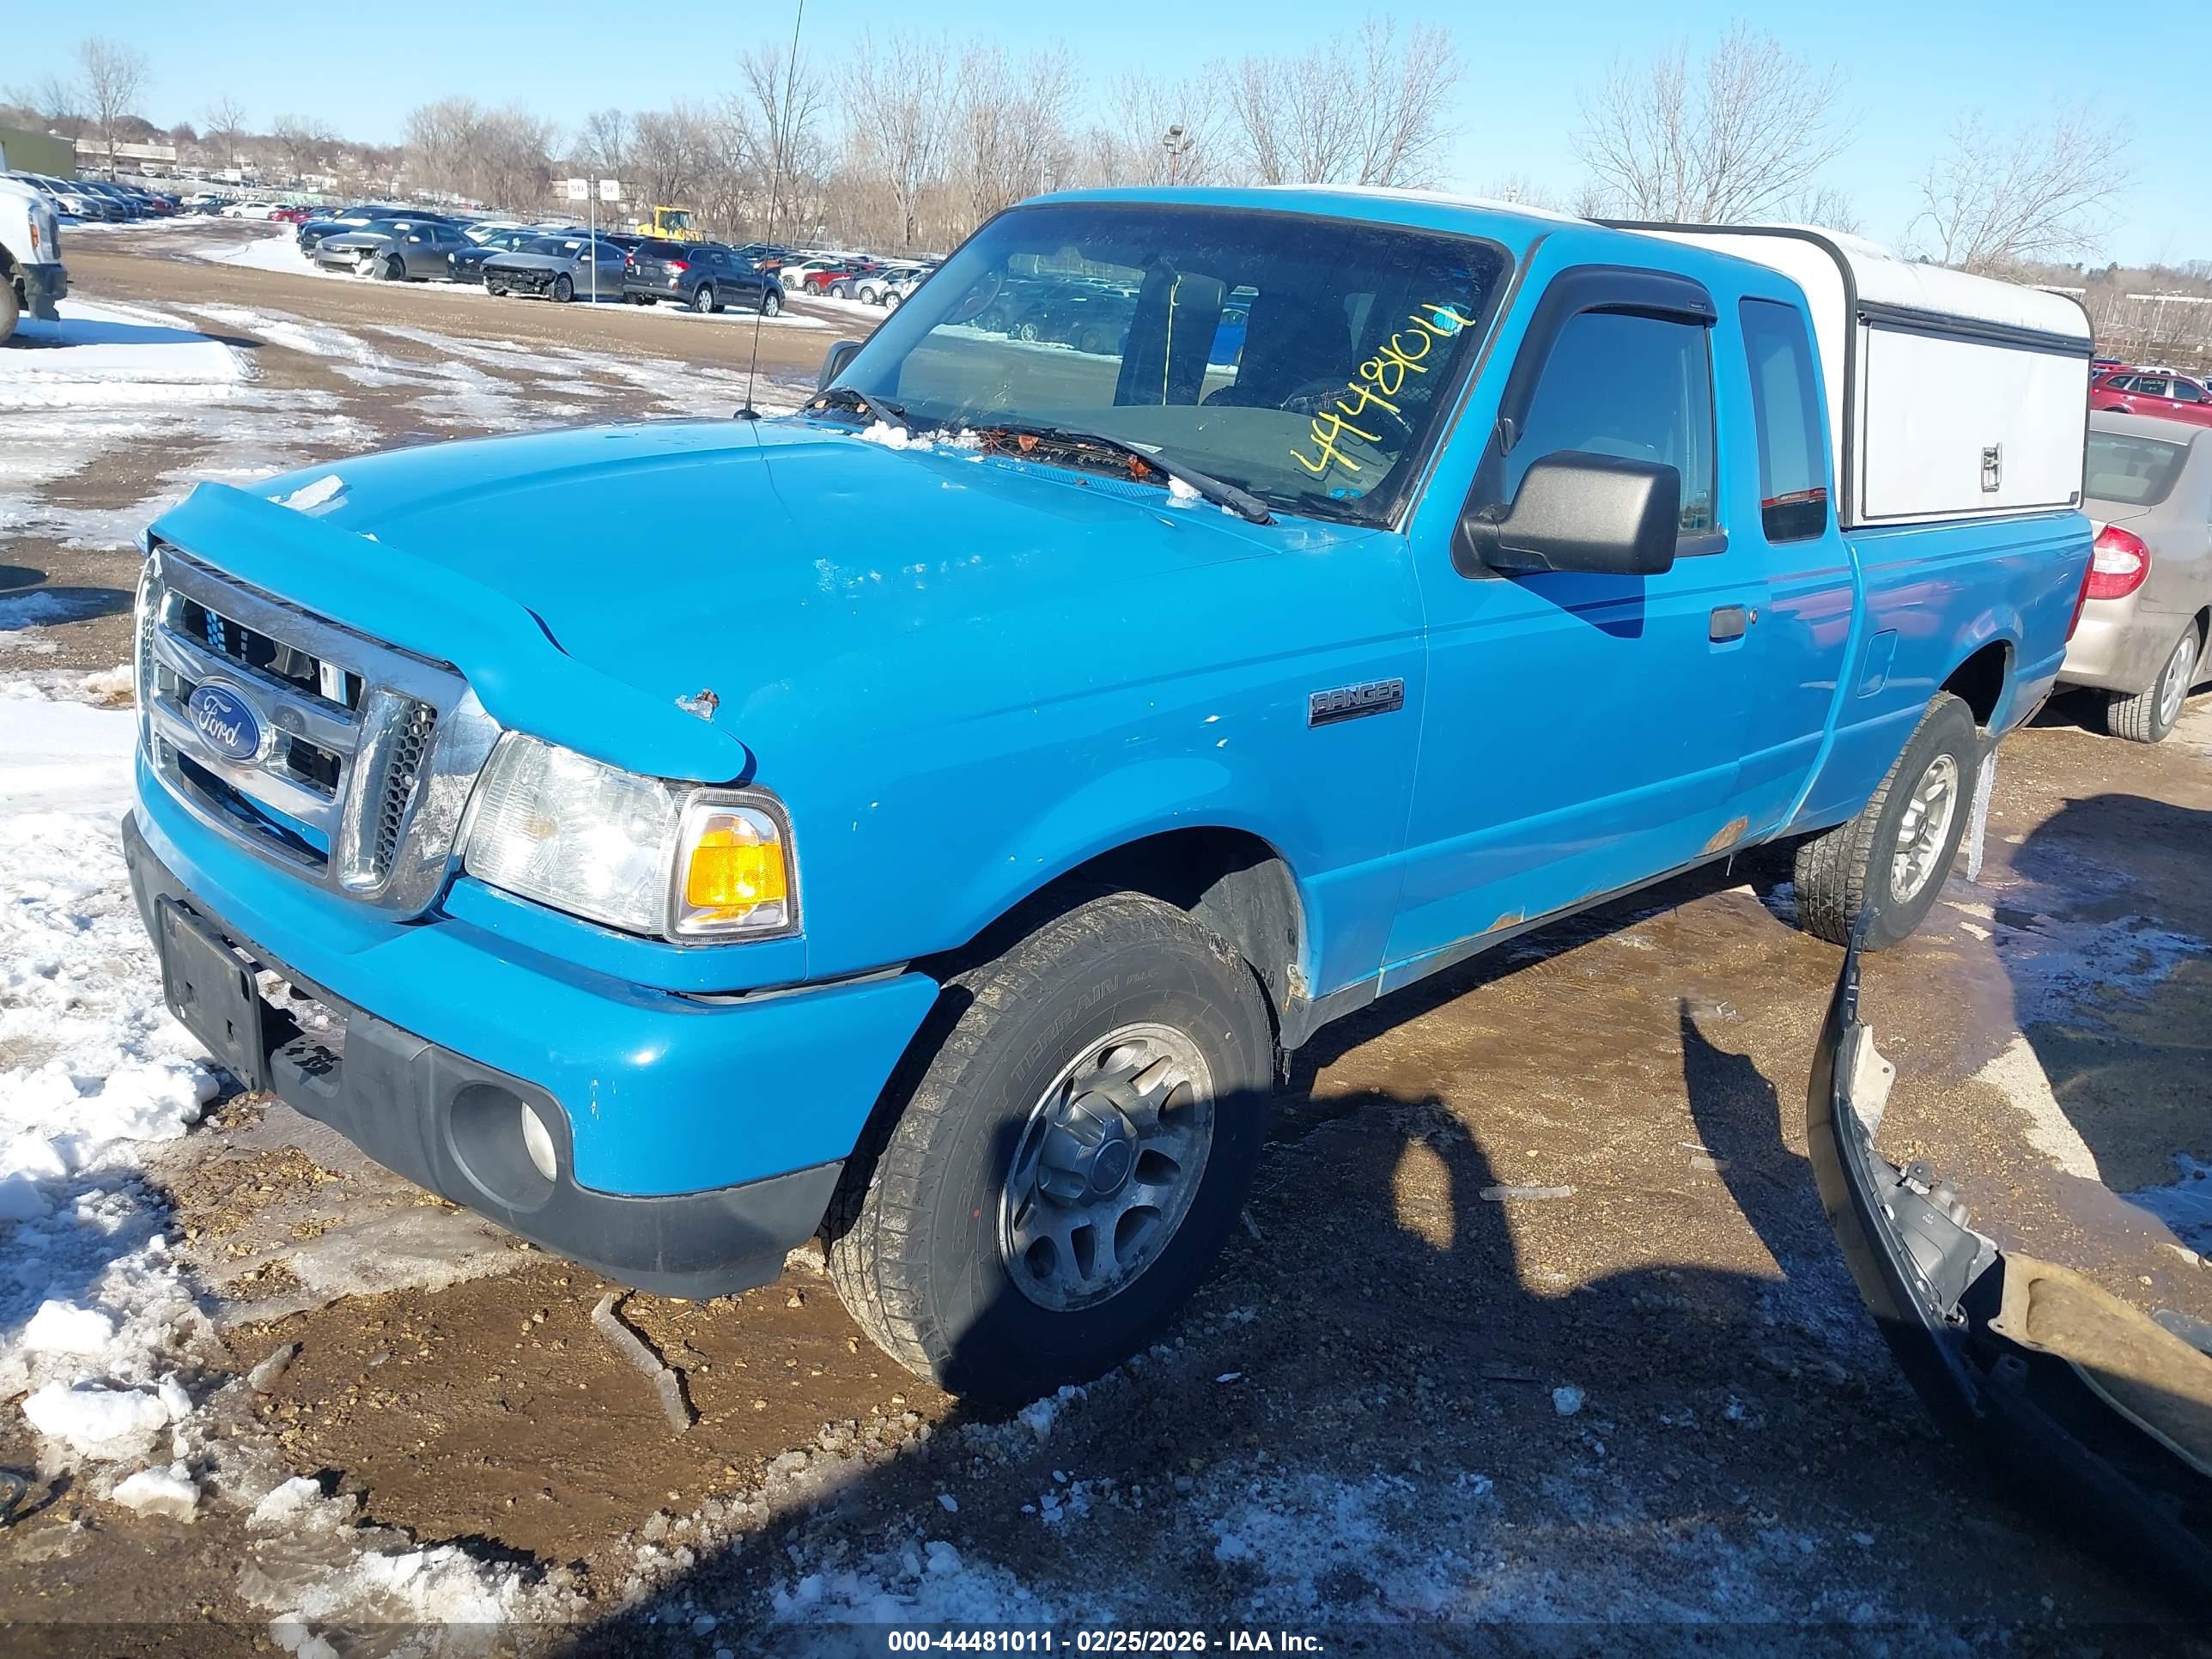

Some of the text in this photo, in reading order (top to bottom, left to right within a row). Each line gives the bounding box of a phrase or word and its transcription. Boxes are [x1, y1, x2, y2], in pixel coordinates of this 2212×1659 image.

[1290, 303, 1476, 472] 44481011
[199, 695, 242, 747] Ford
[1312, 679, 1403, 714] RANGER
[1011, 975, 1120, 1082] TERRAIN
